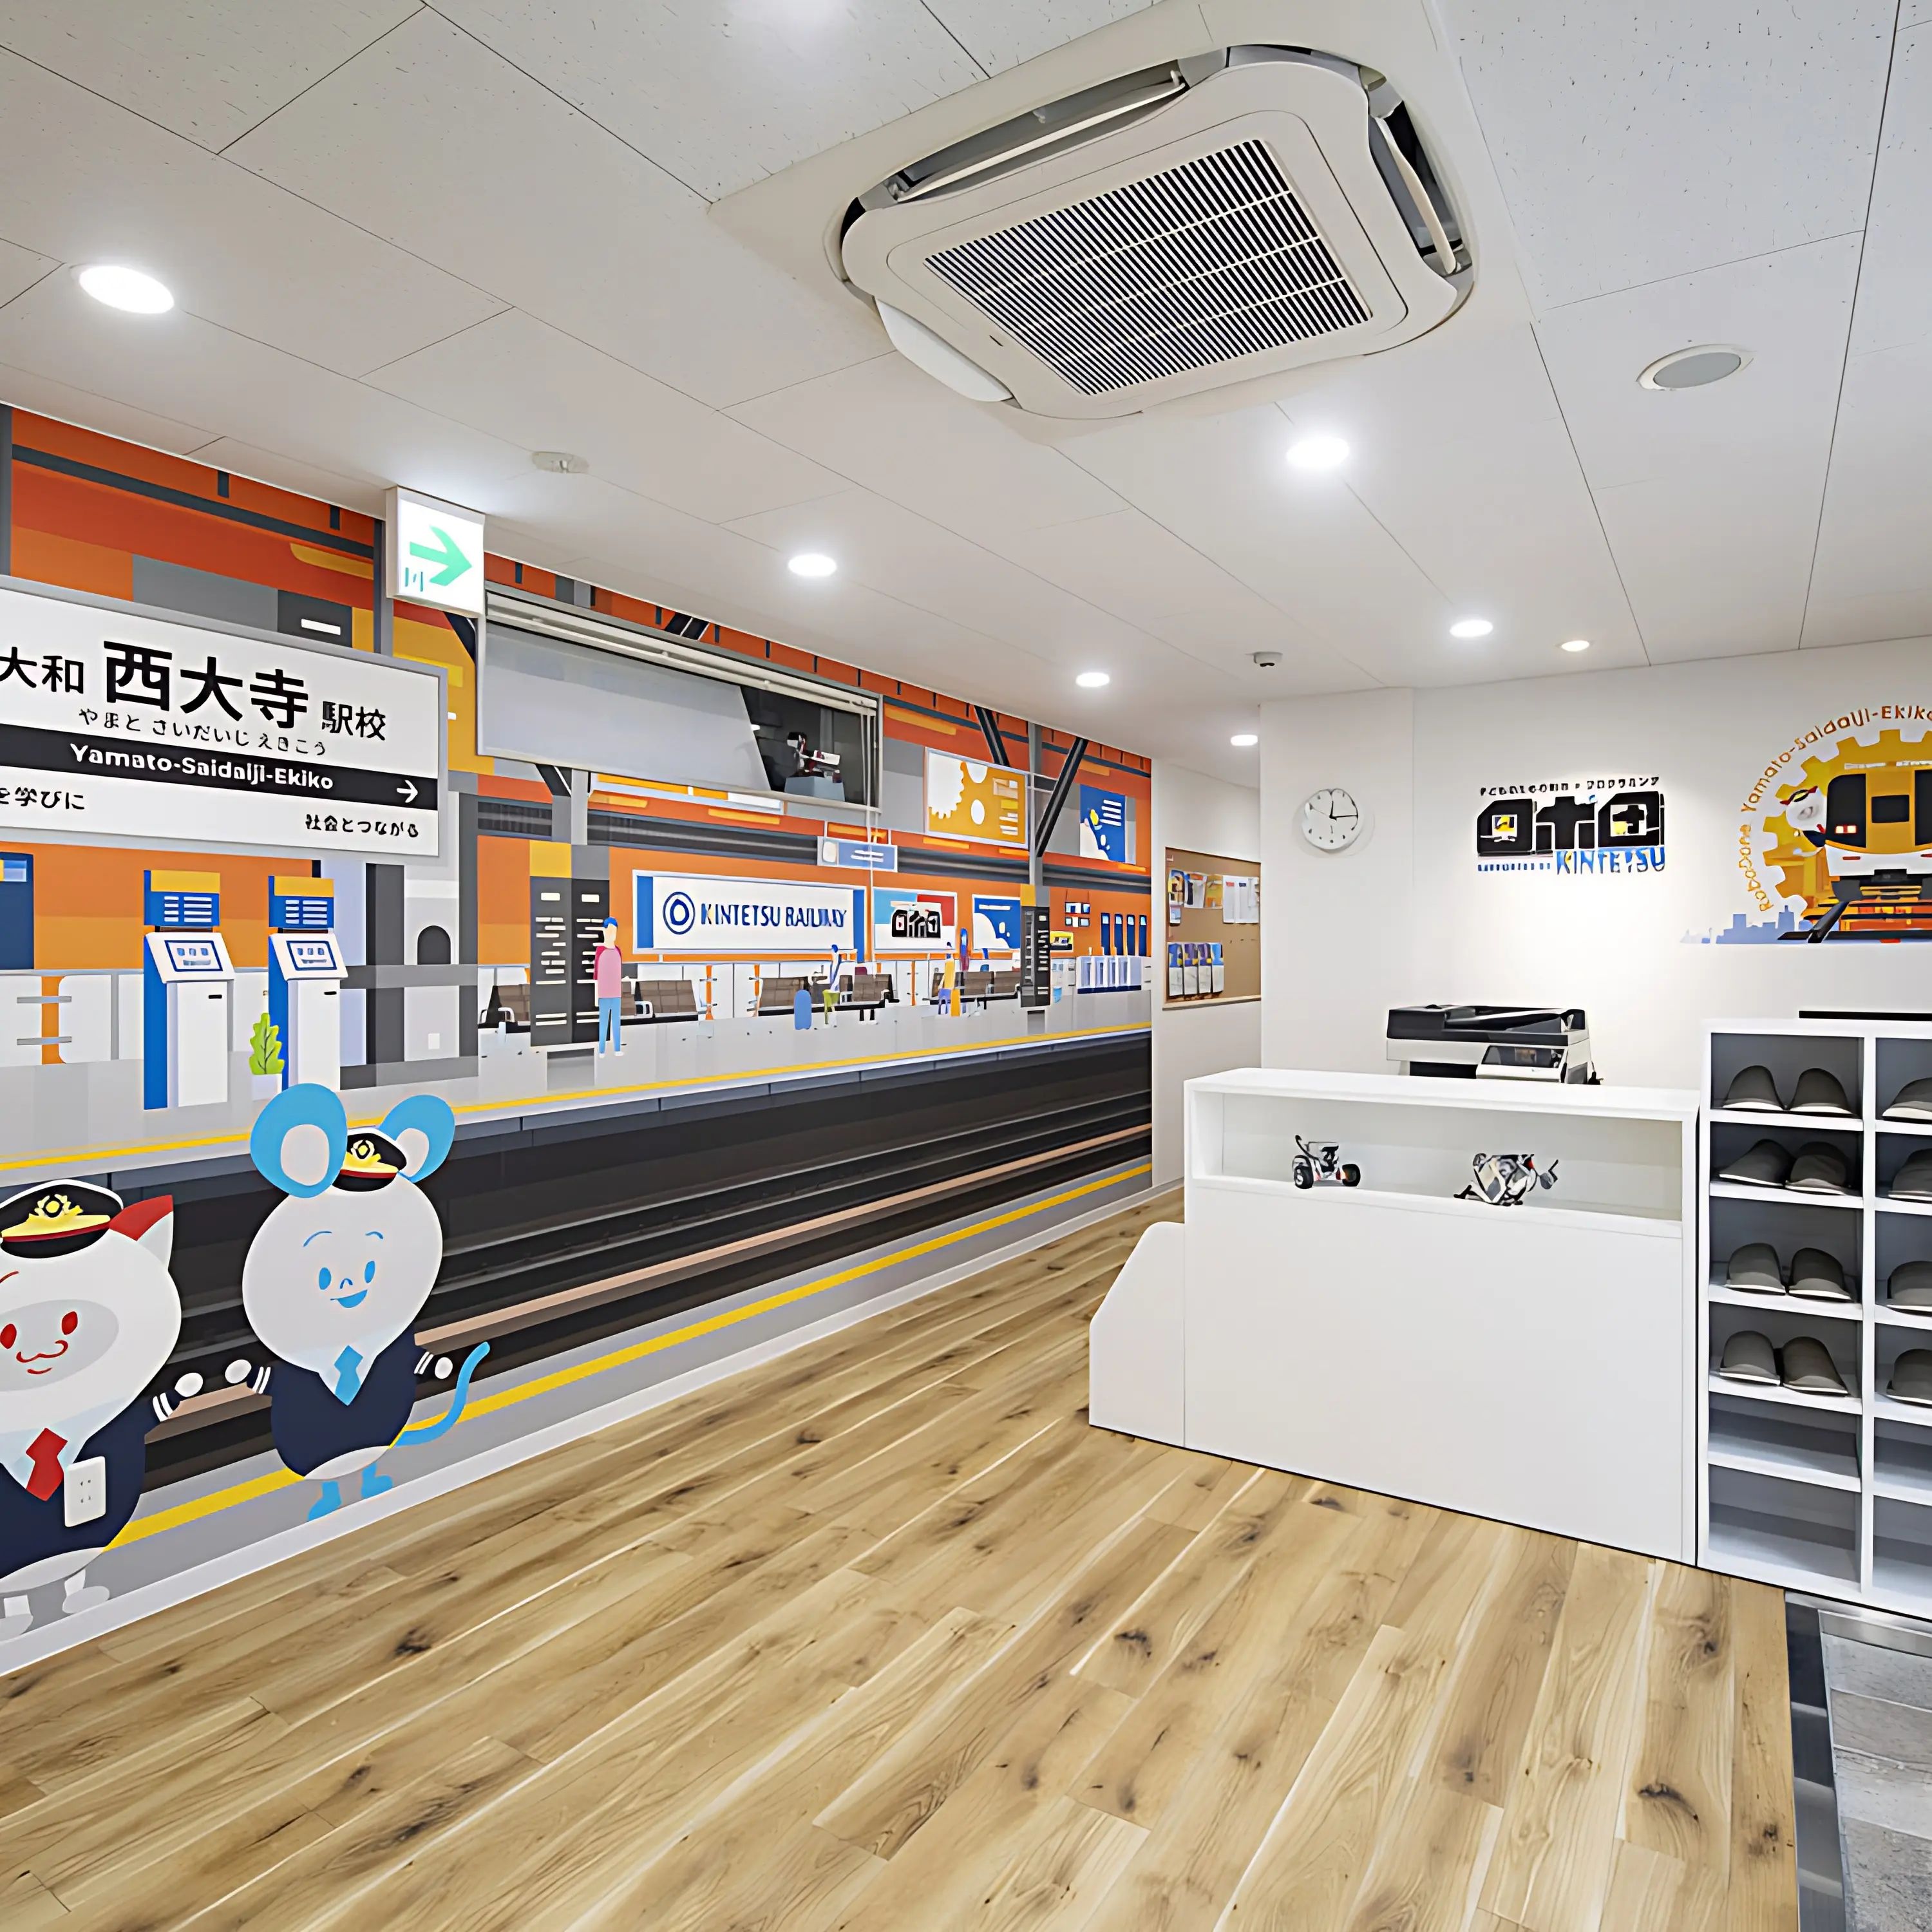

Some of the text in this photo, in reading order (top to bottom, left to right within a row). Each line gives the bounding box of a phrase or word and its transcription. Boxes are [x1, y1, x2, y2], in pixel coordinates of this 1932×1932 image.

[70, 743, 334, 790] Yamato-Saidaiji-Ekiko
[305, 813, 419, 838] 社会とつながる
[1556, 847, 1665, 875] KINTETSU
[701, 903, 781, 927] KINTETSU
